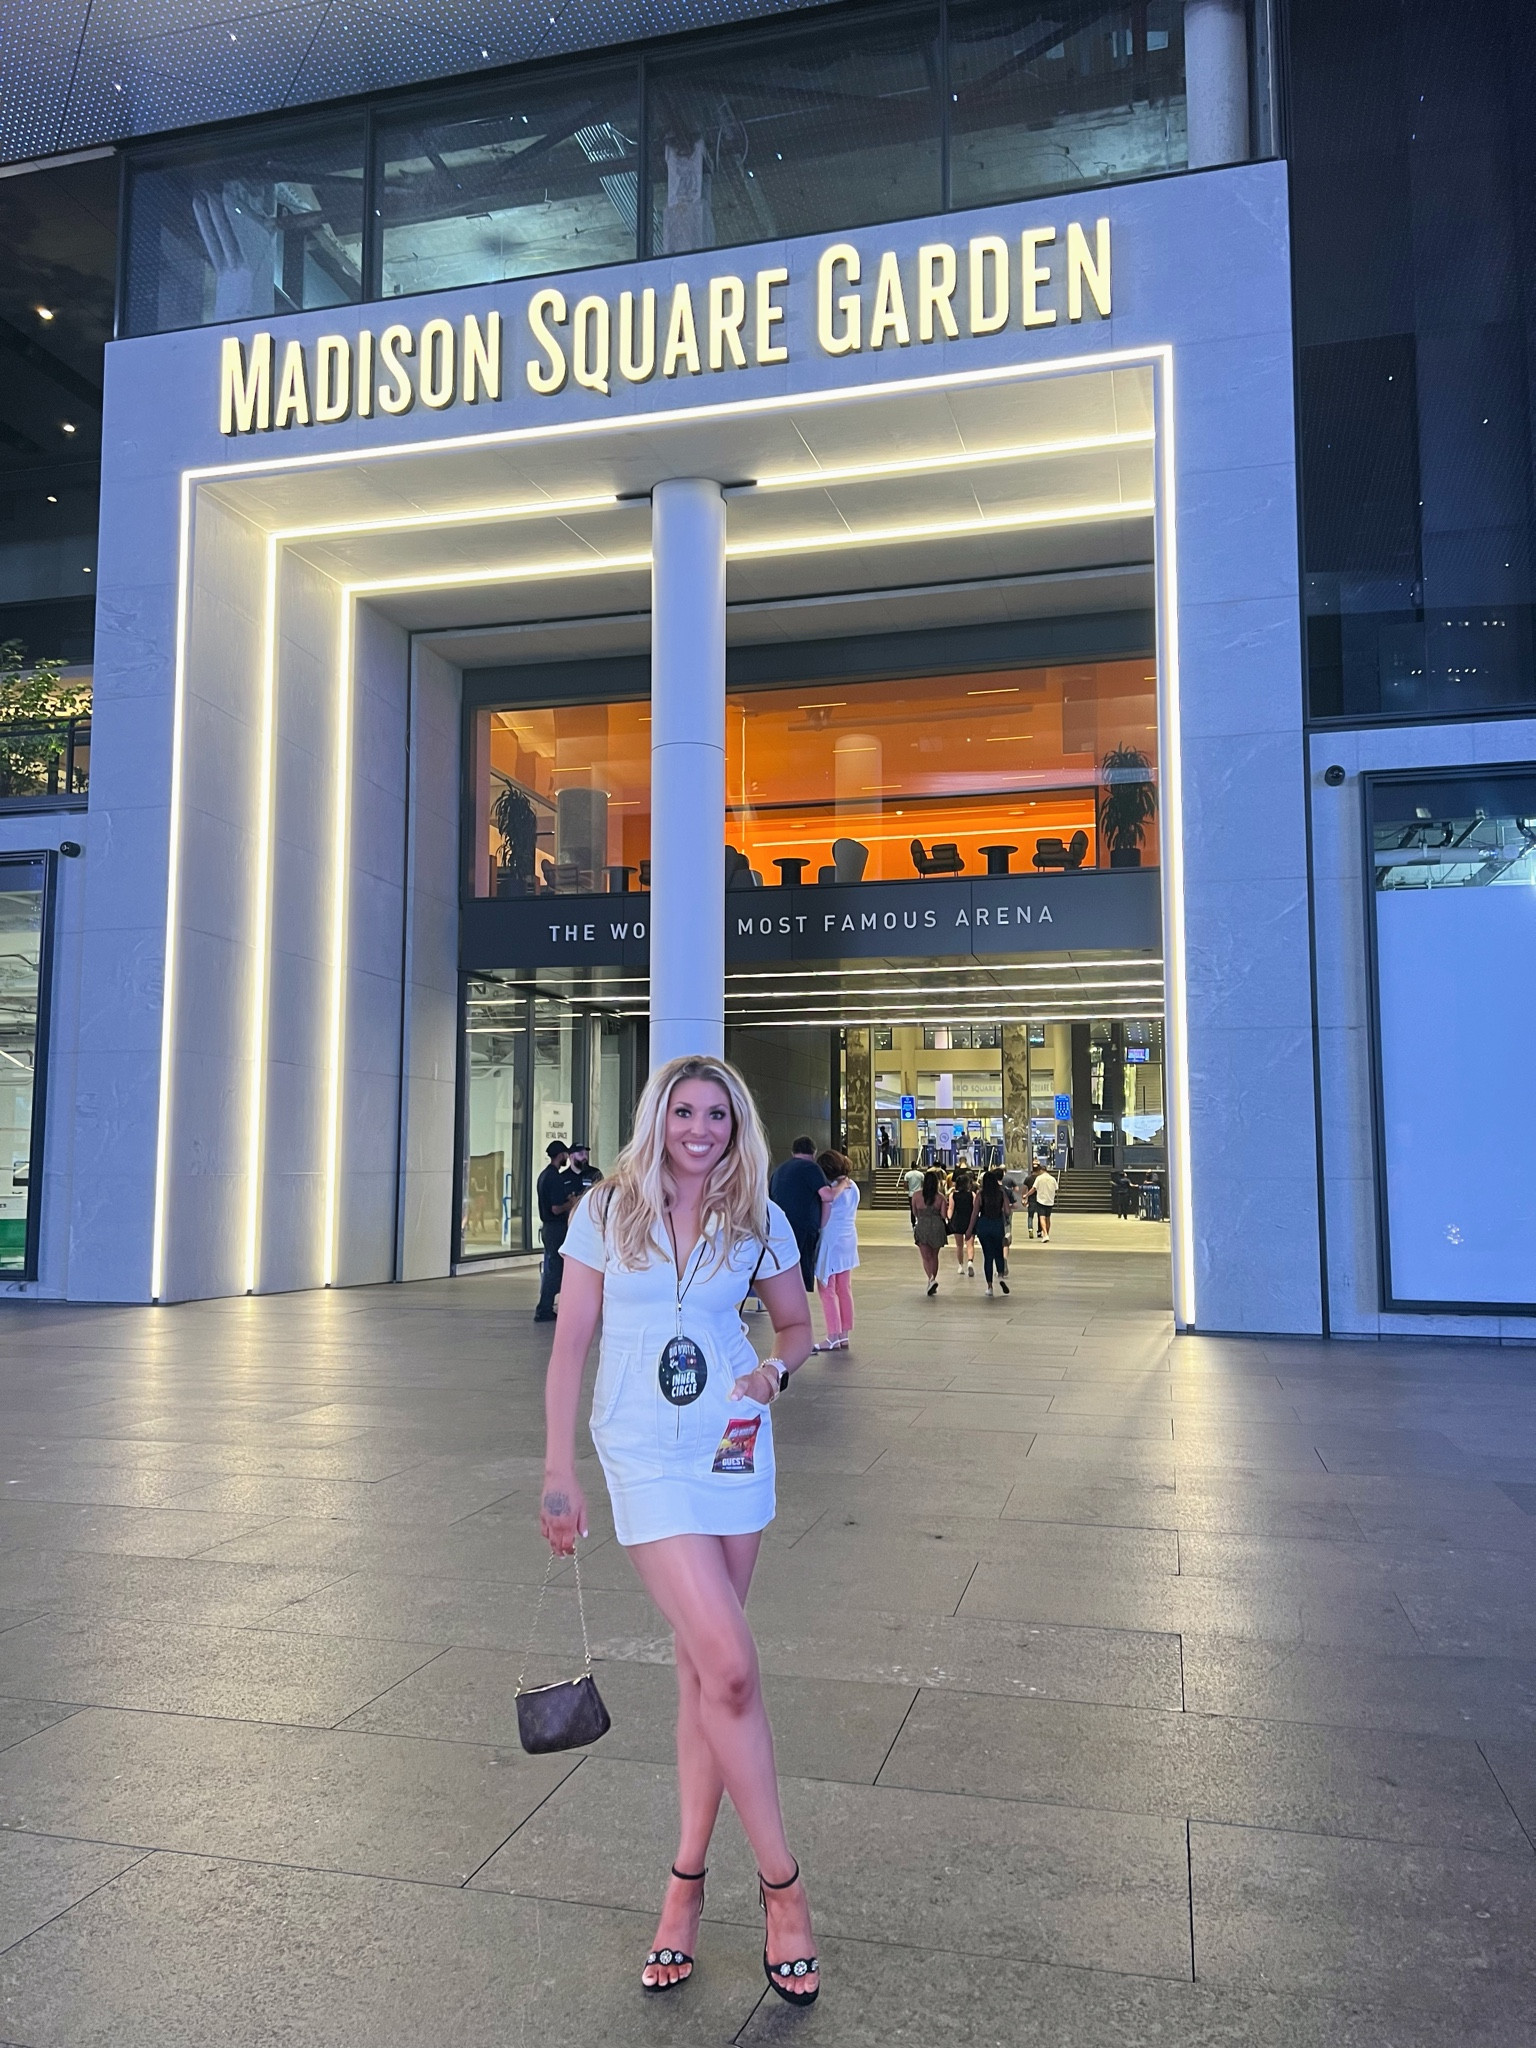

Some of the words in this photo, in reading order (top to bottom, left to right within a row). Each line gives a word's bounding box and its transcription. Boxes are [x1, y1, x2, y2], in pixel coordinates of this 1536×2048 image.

[220, 311, 501, 434] MADISON
[526, 267, 789, 395] SQUARE
[817, 217, 1111, 354] GARDEN
[549, 924, 595, 942] THE
[737, 916, 807, 935] MOST
[824, 910, 937, 932] FAMOUS
[955, 905, 1053, 926] ARENA
[672, 1371, 696, 1387] INNER
[671, 1383, 697, 1398] CIRCLE
[722, 1457, 745, 1466] GUEST
